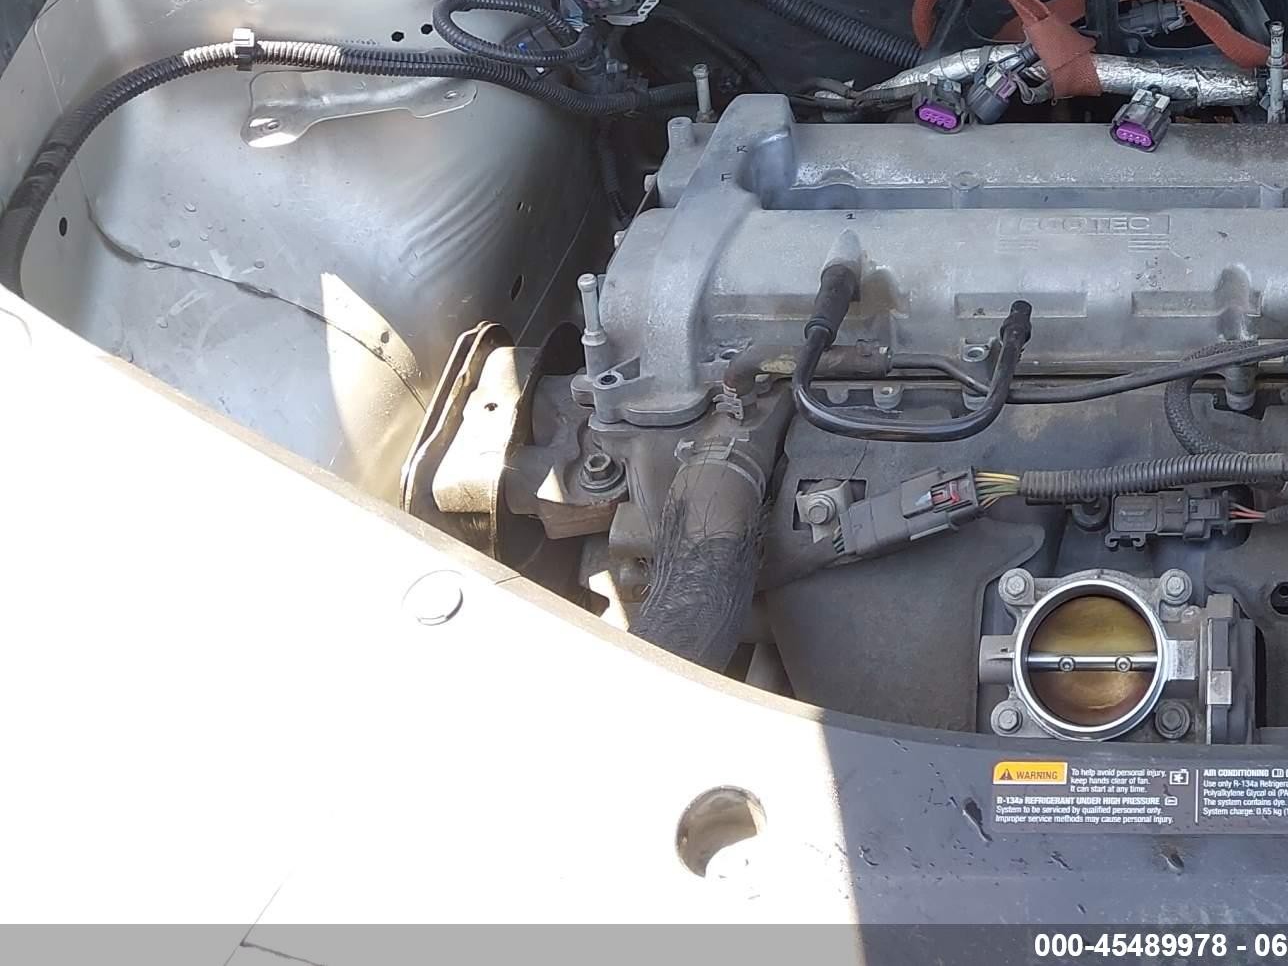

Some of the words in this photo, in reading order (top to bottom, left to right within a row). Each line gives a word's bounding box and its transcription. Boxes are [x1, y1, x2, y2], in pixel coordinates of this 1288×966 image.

[1017, 216, 1151, 231] ECOTEC
[1016, 771, 1058, 780] WARNING
[1071, 768, 1080, 776] To
[1081, 768, 1095, 777] help
[1097, 768, 1115, 776] avoid
[1116, 768, 1145, 777] personal
[1203, 769, 1217, 777] AIR
[1217, 769, 1270, 777] CONDITIONING
[1070, 777, 1087, 786] keep
[1089, 777, 1109, 785] hands
[1110, 777, 1128, 785] clear
[1129, 777, 1137, 785] of
[1137, 777, 1150, 785] fan.
[1217, 780, 1232, 788] only
[1070, 785, 1075, 793] It
[1076, 785, 1089, 793] can
[1090, 785, 1106, 793] start
[1107, 785, 1115, 793] at
[1116, 786, 1129, 794] any
[1130, 785, 1147, 793] time.
[1203, 789, 1245, 798] Polyalkylene
[1246, 789, 1267, 798] Glycol
[1267, 789, 1276, 797] oil
[996, 796, 1024, 805] R-134a
[1024, 796, 1075, 805] REFRIGERANT
[1075, 796, 1102, 805] UNDER
[1102, 796, 1121, 805] HIGH
[1122, 796, 1161, 805] PRESSURE
[1217, 798, 1242, 806] system
[1272, 798, 1287, 807] dye.
[995, 805, 1022, 815] System
[1071, 806, 1081, 815] by
[1081, 806, 1111, 815] qualified
[1111, 806, 1146, 815] personnel
[1203, 808, 1228, 816] System
[1272, 808, 1282, 816] kg
[995, 815, 1027, 824] Improper
[1027, 815, 1053, 823] service
[1053, 815, 1084, 823] methods
[1084, 816, 1100, 824] may
[1100, 815, 1122, 823] cause
[1122, 816, 1152, 824] personal
